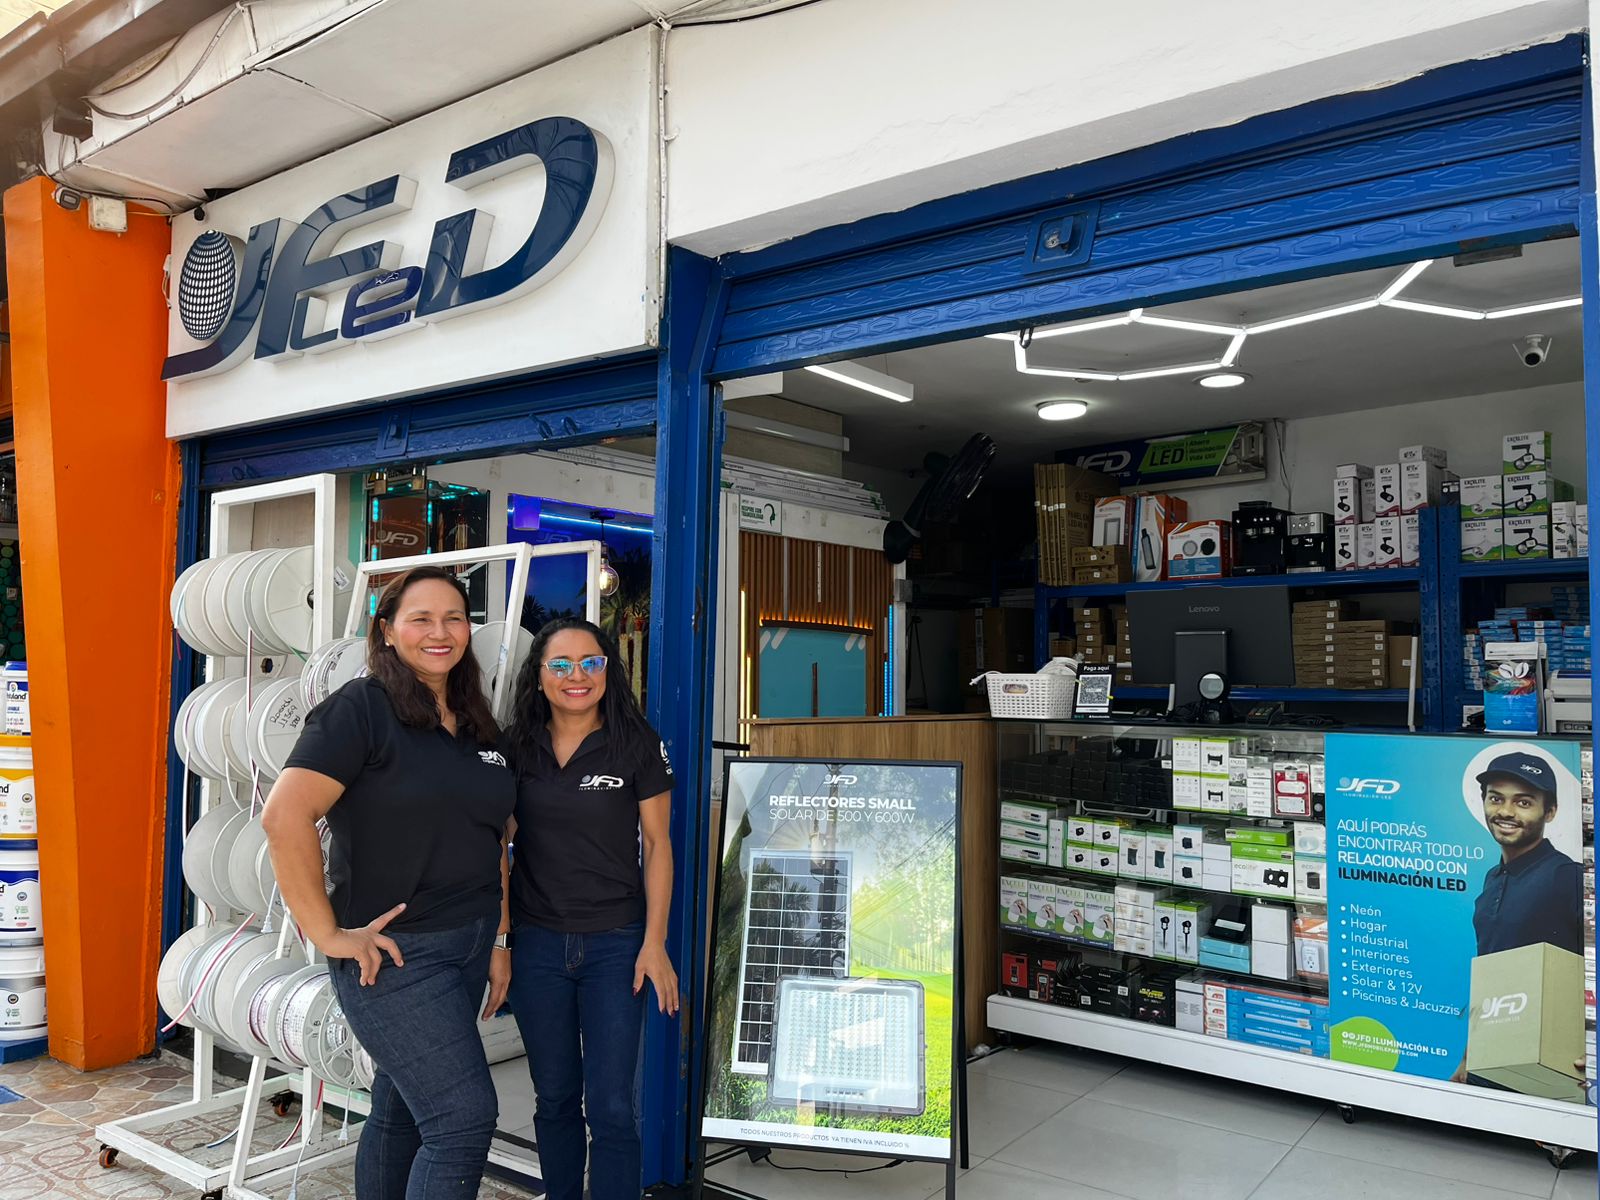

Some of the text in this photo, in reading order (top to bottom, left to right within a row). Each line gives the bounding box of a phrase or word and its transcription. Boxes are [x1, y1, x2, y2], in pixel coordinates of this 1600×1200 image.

[1149, 448, 1184, 466] LED
[1188, 605, 1221, 613] Lenovo
[579, 774, 625, 788] JFD
[823, 774, 858, 785] JFD
[1336, 777, 1401, 794] JFD
[769, 795, 916, 811] REFLECTORES SMALL
[768, 808, 916, 824] SOLAR DE 500 Y 600W
[1336, 817, 1427, 837] AQUÍ PODRÁS
[1337, 834, 1484, 860] ENCONTRAR TODO LO
[1337, 851, 1468, 875] RELACIONADO CON
[1338, 867, 1467, 892] ILUMINACIÓN LED
[1350, 904, 1382, 918] Neón
[1350, 918, 1387, 934] Hogar
[1351, 932, 1409, 950] Industrial
[1351, 946, 1411, 964] Interiores
[1352, 961, 1413, 979] Exteriores
[1352, 975, 1423, 995] Solar & 12V
[1352, 989, 1461, 1017] Piscinas & Jacuzzis
[1480, 992, 1528, 1019] JFD
[1355, 1033, 1371, 1043] JFD
[1373, 1037, 1429, 1054] ILUMINACIÓN
[1430, 1047, 1448, 1057] LED
[740, 1128, 760, 1136] TODOS
[761, 1130, 792, 1139] NUESTROS
[792, 1132, 829, 1142] PRODUCTOS
[840, 1136, 862, 1144] TIENEN
[862, 1138, 873, 1146] IVA
[873, 1139, 904, 1148] INCLUIDO
